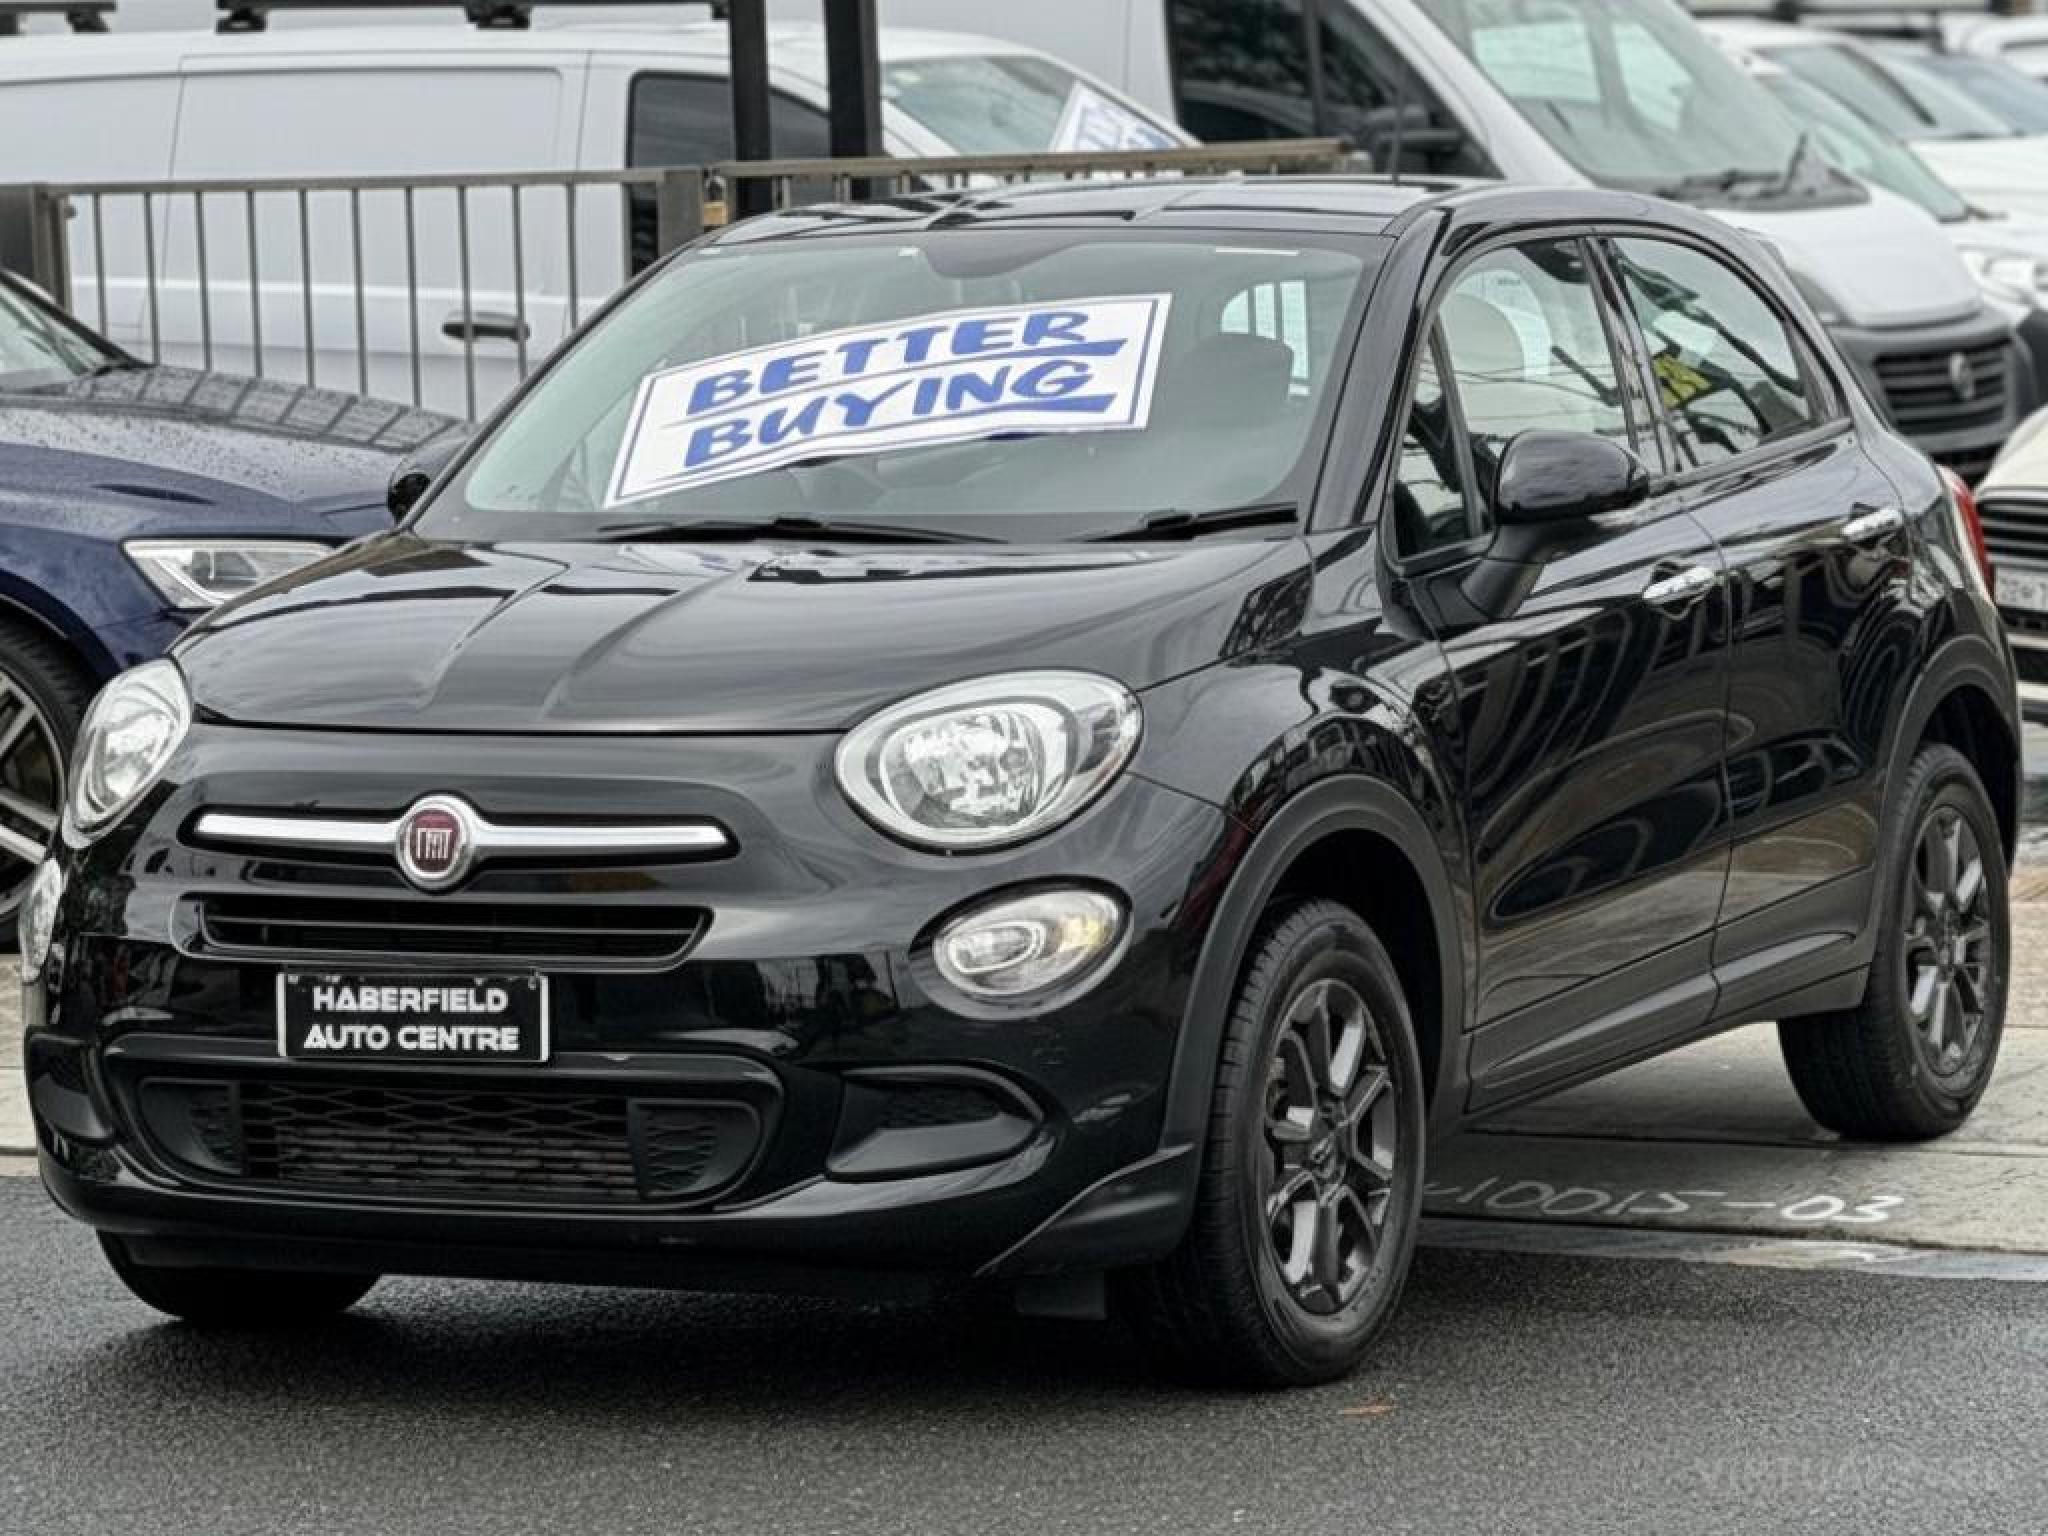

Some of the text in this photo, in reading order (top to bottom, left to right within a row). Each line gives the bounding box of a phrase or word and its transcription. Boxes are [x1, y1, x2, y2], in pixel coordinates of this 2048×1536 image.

[686, 311, 1089, 416] BETTER
[684, 359, 1094, 468] BUYING
[415, 827, 453, 859] FIAT
[312, 986, 509, 1012] HABERFIELD
[303, 1024, 521, 1051] AUTO CENTRE
